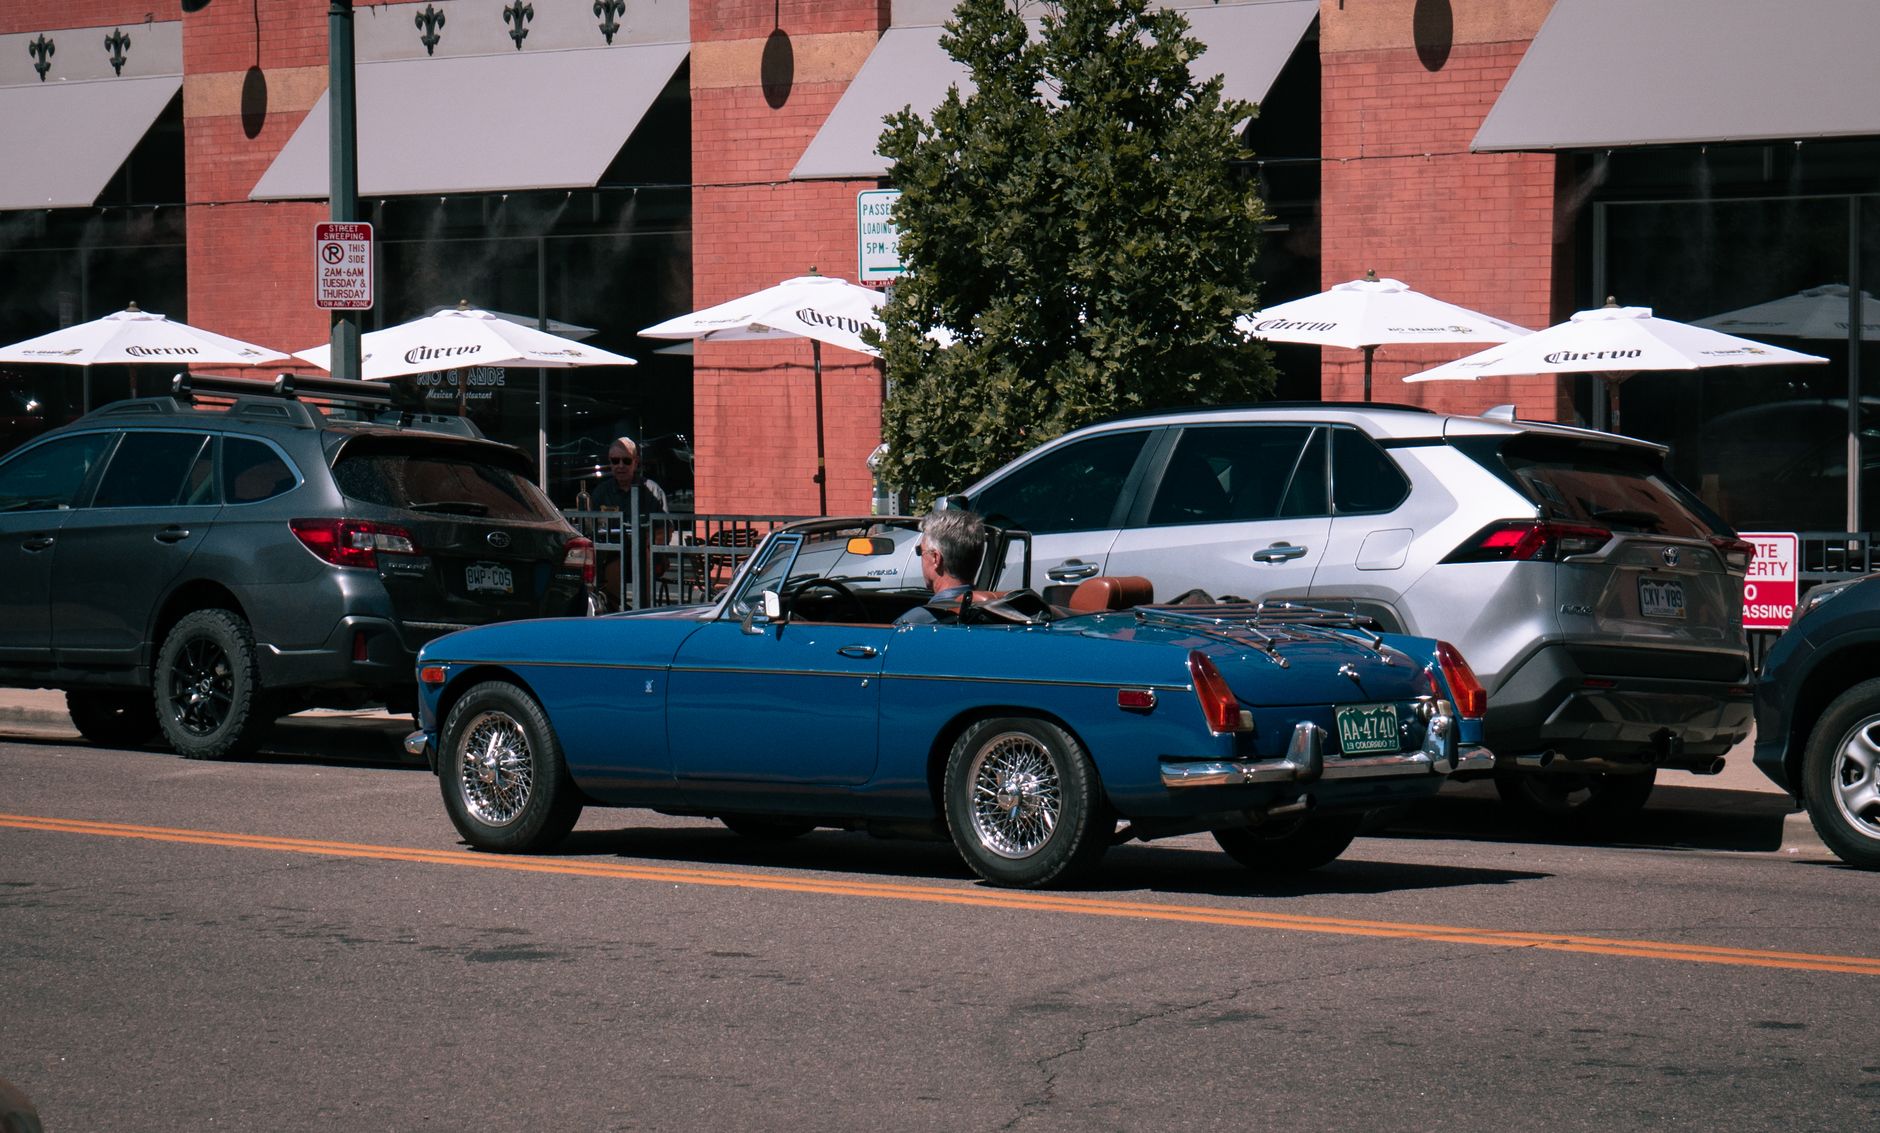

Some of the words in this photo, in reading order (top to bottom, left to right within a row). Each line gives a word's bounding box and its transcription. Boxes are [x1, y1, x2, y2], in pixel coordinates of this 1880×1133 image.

[328, 225, 359, 233] STREET
[863, 223, 892, 235] LOADING
[323, 232, 364, 240] SWEEPING
[348, 244, 366, 253] THIS
[348, 255, 366, 264] SIDE
[324, 268, 364, 277] 2AM-6AM
[322, 279, 357, 288] TUESDAY
[360, 279, 366, 288] &
[322, 289, 366, 298] THURSDAY
[1255, 318, 1337, 331] Cuervo
[125, 345, 199, 357] Cuervo
[404, 344, 482, 364] Cuervo
[1543, 349, 1642, 364] Cuervo
[416, 371, 442, 386] RIO
[447, 367, 505, 386] GANDE
[425, 388, 453, 399] Mexican
[456, 388, 493, 399] Rstaurant
[1747, 561, 1788, 576] ERTY
[1744, 583, 1758, 601] O
[1743, 604, 1793, 619] ASSING
[1355, 740, 1387, 749] COLORADO
